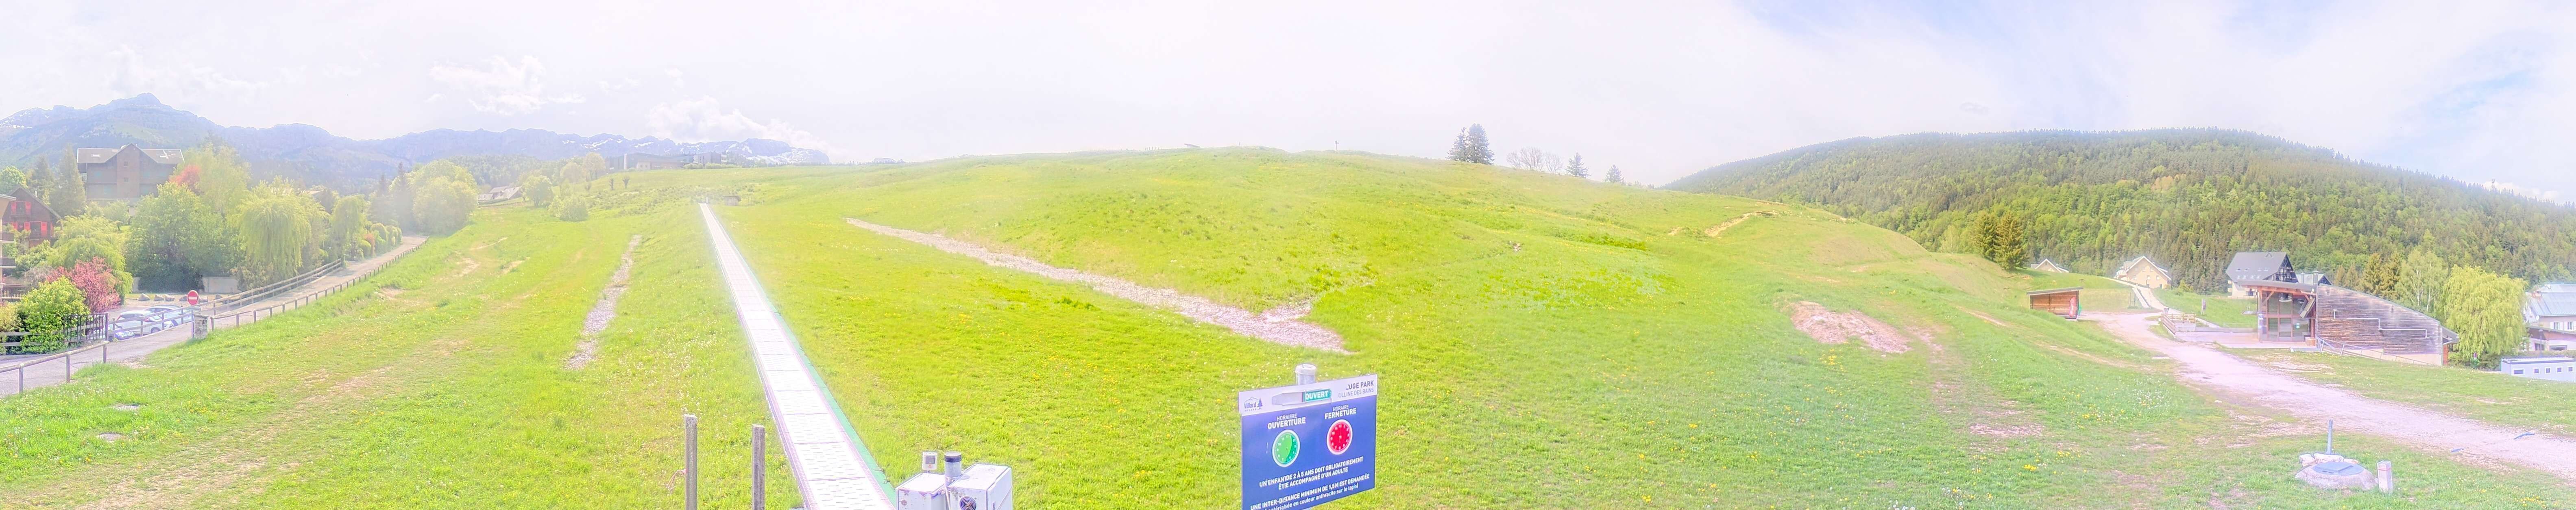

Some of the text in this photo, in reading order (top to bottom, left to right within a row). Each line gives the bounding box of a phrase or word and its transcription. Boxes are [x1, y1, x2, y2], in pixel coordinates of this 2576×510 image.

[1305, 391, 1329, 400] OUVERT
[1324, 407, 1357, 420] FERMETURE
[1325, 456, 1364, 471] OBLIGATOIREMENT
[1289, 473, 1321, 487] ACCOMPAGNÉ
[1332, 467, 1348, 476] ADULTE
[1301, 487, 1321, 497] MINIMUM
[1347, 473, 1370, 484] DEMANDÉE
[1299, 496, 1316, 504] couleur
[1316, 490, 1336, 500] anthracite
